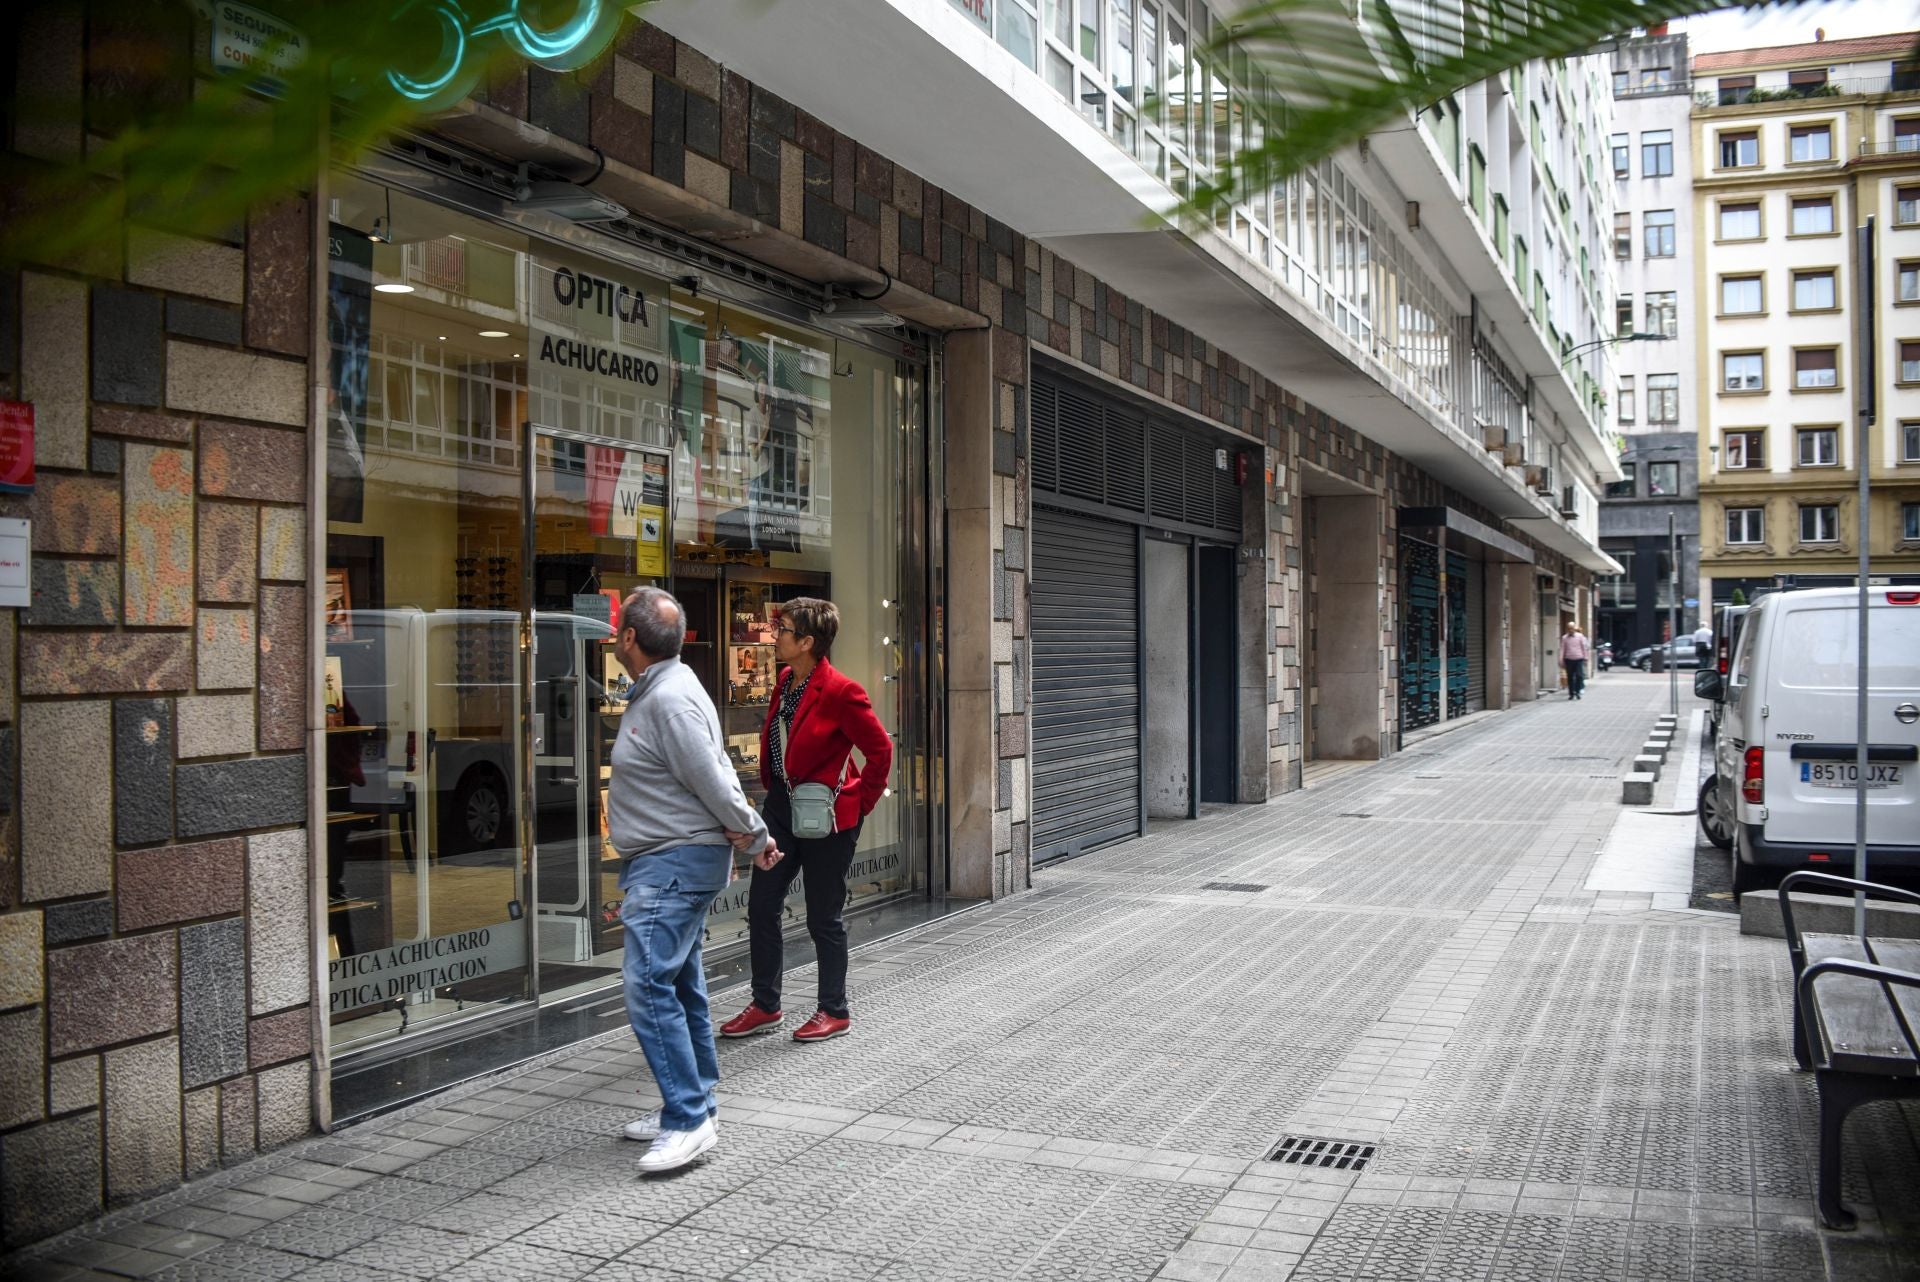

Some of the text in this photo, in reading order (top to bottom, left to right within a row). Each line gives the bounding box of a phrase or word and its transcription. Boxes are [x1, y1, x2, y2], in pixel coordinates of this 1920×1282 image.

[553, 266, 649, 328] OPTICA
[540, 335, 659, 387] ACHUCARRO
[762, 526, 786, 535] LONDON
[1813, 764, 1899, 782] 8510 JXZ
[847, 853, 899, 879] DIPUTACION
[387, 928, 490, 969] ACHUCARRO
[388, 956, 487, 998] DIPUTACION
